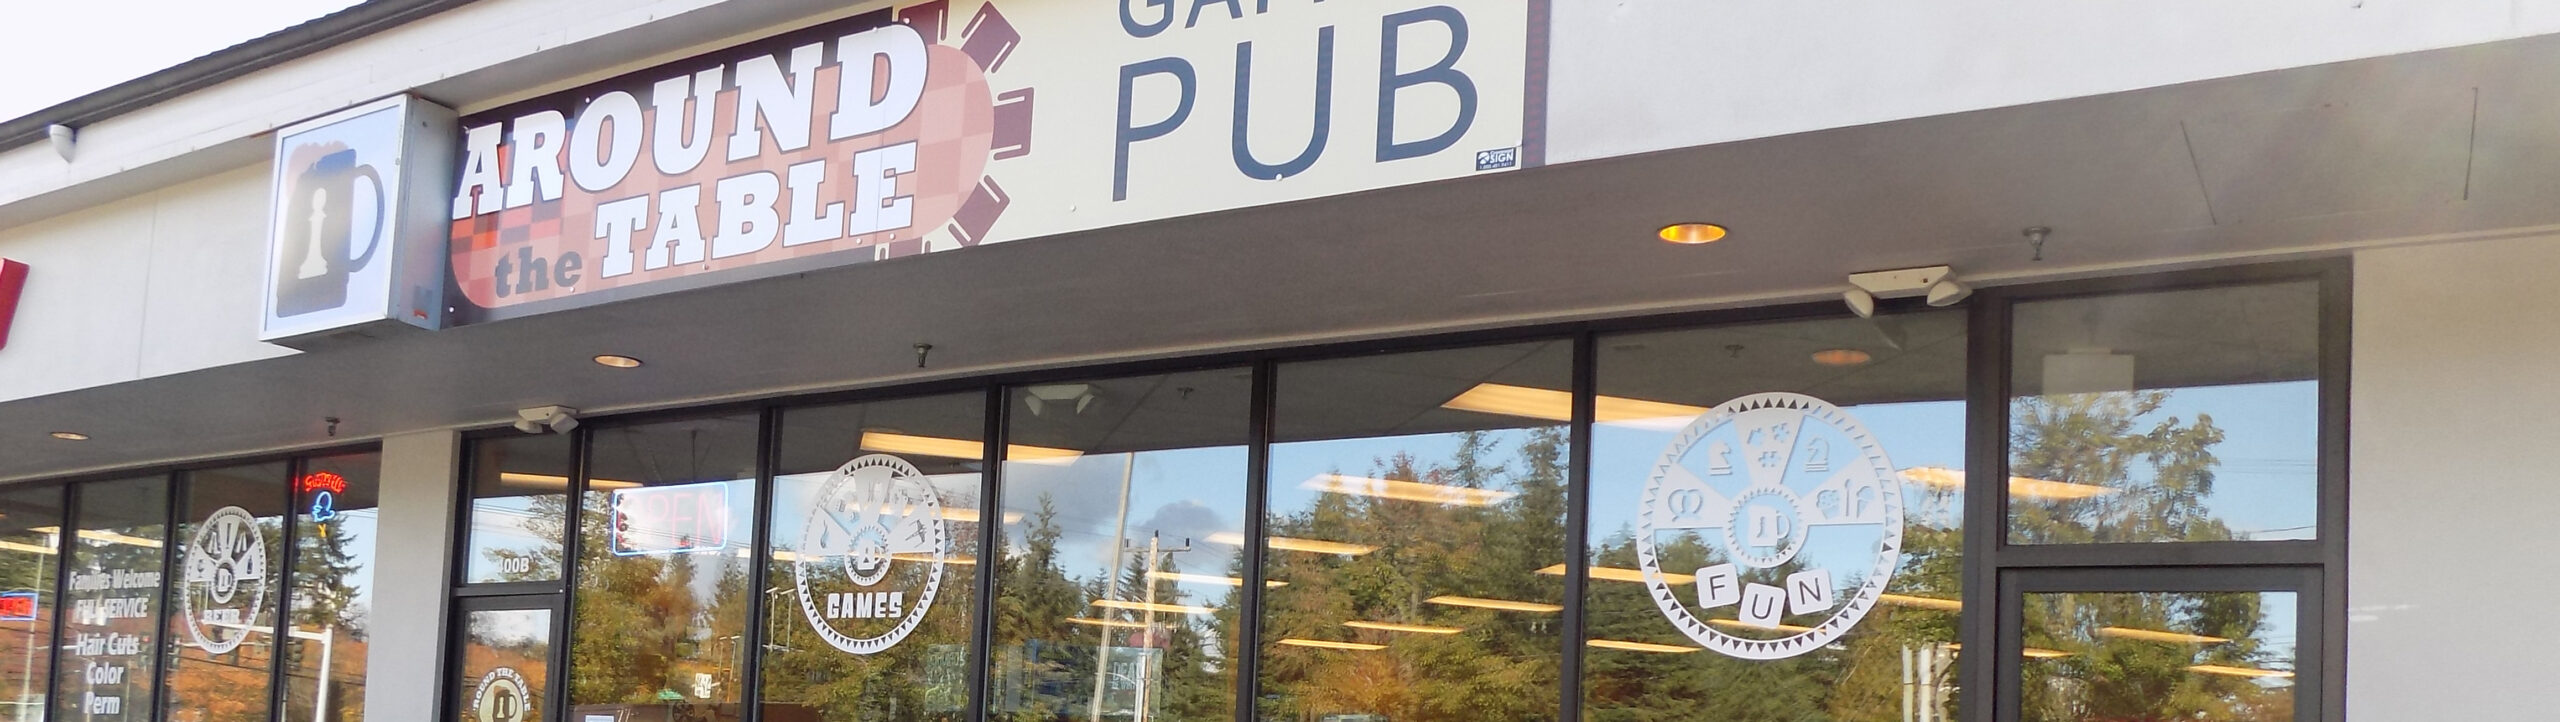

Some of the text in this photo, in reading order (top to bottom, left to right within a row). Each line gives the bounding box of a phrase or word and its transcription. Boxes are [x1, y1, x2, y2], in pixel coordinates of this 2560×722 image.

[1112, 5, 1478, 202] PUB
[453, 24, 928, 219] AROUND
[1490, 153, 1513, 163] SIGN
[495, 142, 917, 298] the TABLE
[112, 568, 161, 588] Welcome
[104, 597, 149, 618] SERVICE
[827, 592, 903, 619] GAMES
[1709, 573, 1822, 620] FUN
[75, 632, 139, 655] Hair Cuts
[86, 661, 124, 685] Color
[496, 667, 514, 677] THE
[513, 673, 531, 711] TABLE
[84, 691, 120, 715] Perm
